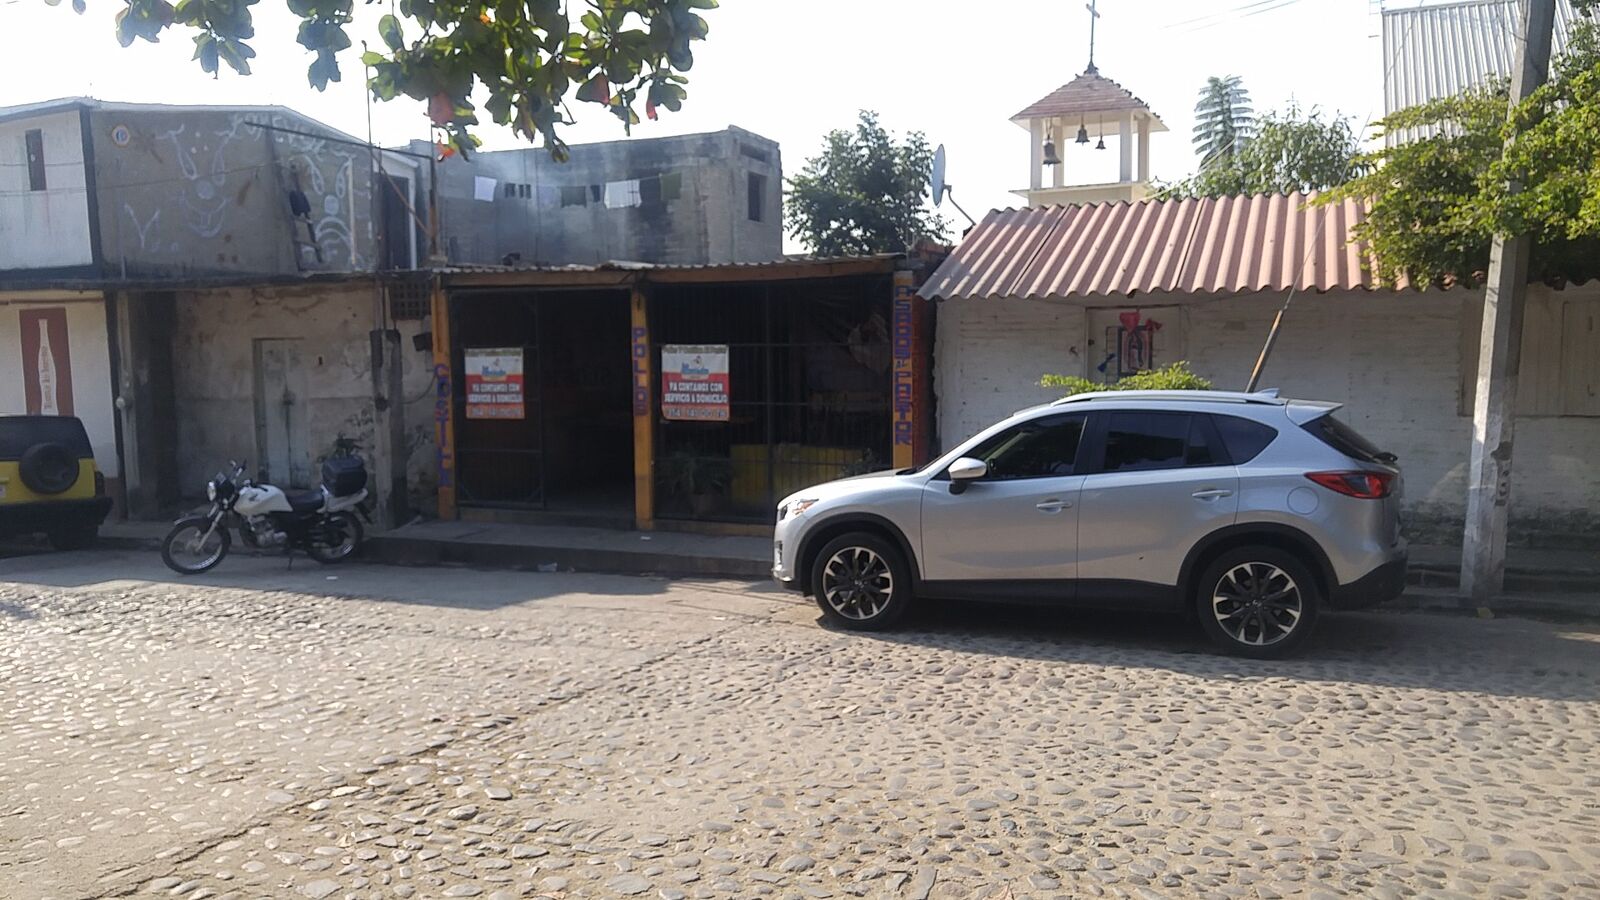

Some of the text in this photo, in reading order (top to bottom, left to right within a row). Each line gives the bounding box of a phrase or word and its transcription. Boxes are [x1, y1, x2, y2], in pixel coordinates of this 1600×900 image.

[632, 327, 648, 416] POLLOS
[472, 384, 480, 392] YA
[508, 383, 520, 392] CON
[669, 382, 678, 392] YA
[710, 383, 723, 392] CON
[467, 393, 492, 403] SERVICIO
[497, 394, 523, 403] DOMICILIO
[664, 393, 691, 403] SERVICIO
[696, 394, 728, 404] DOMICILIO
[895, 371, 912, 445] PASTOR
